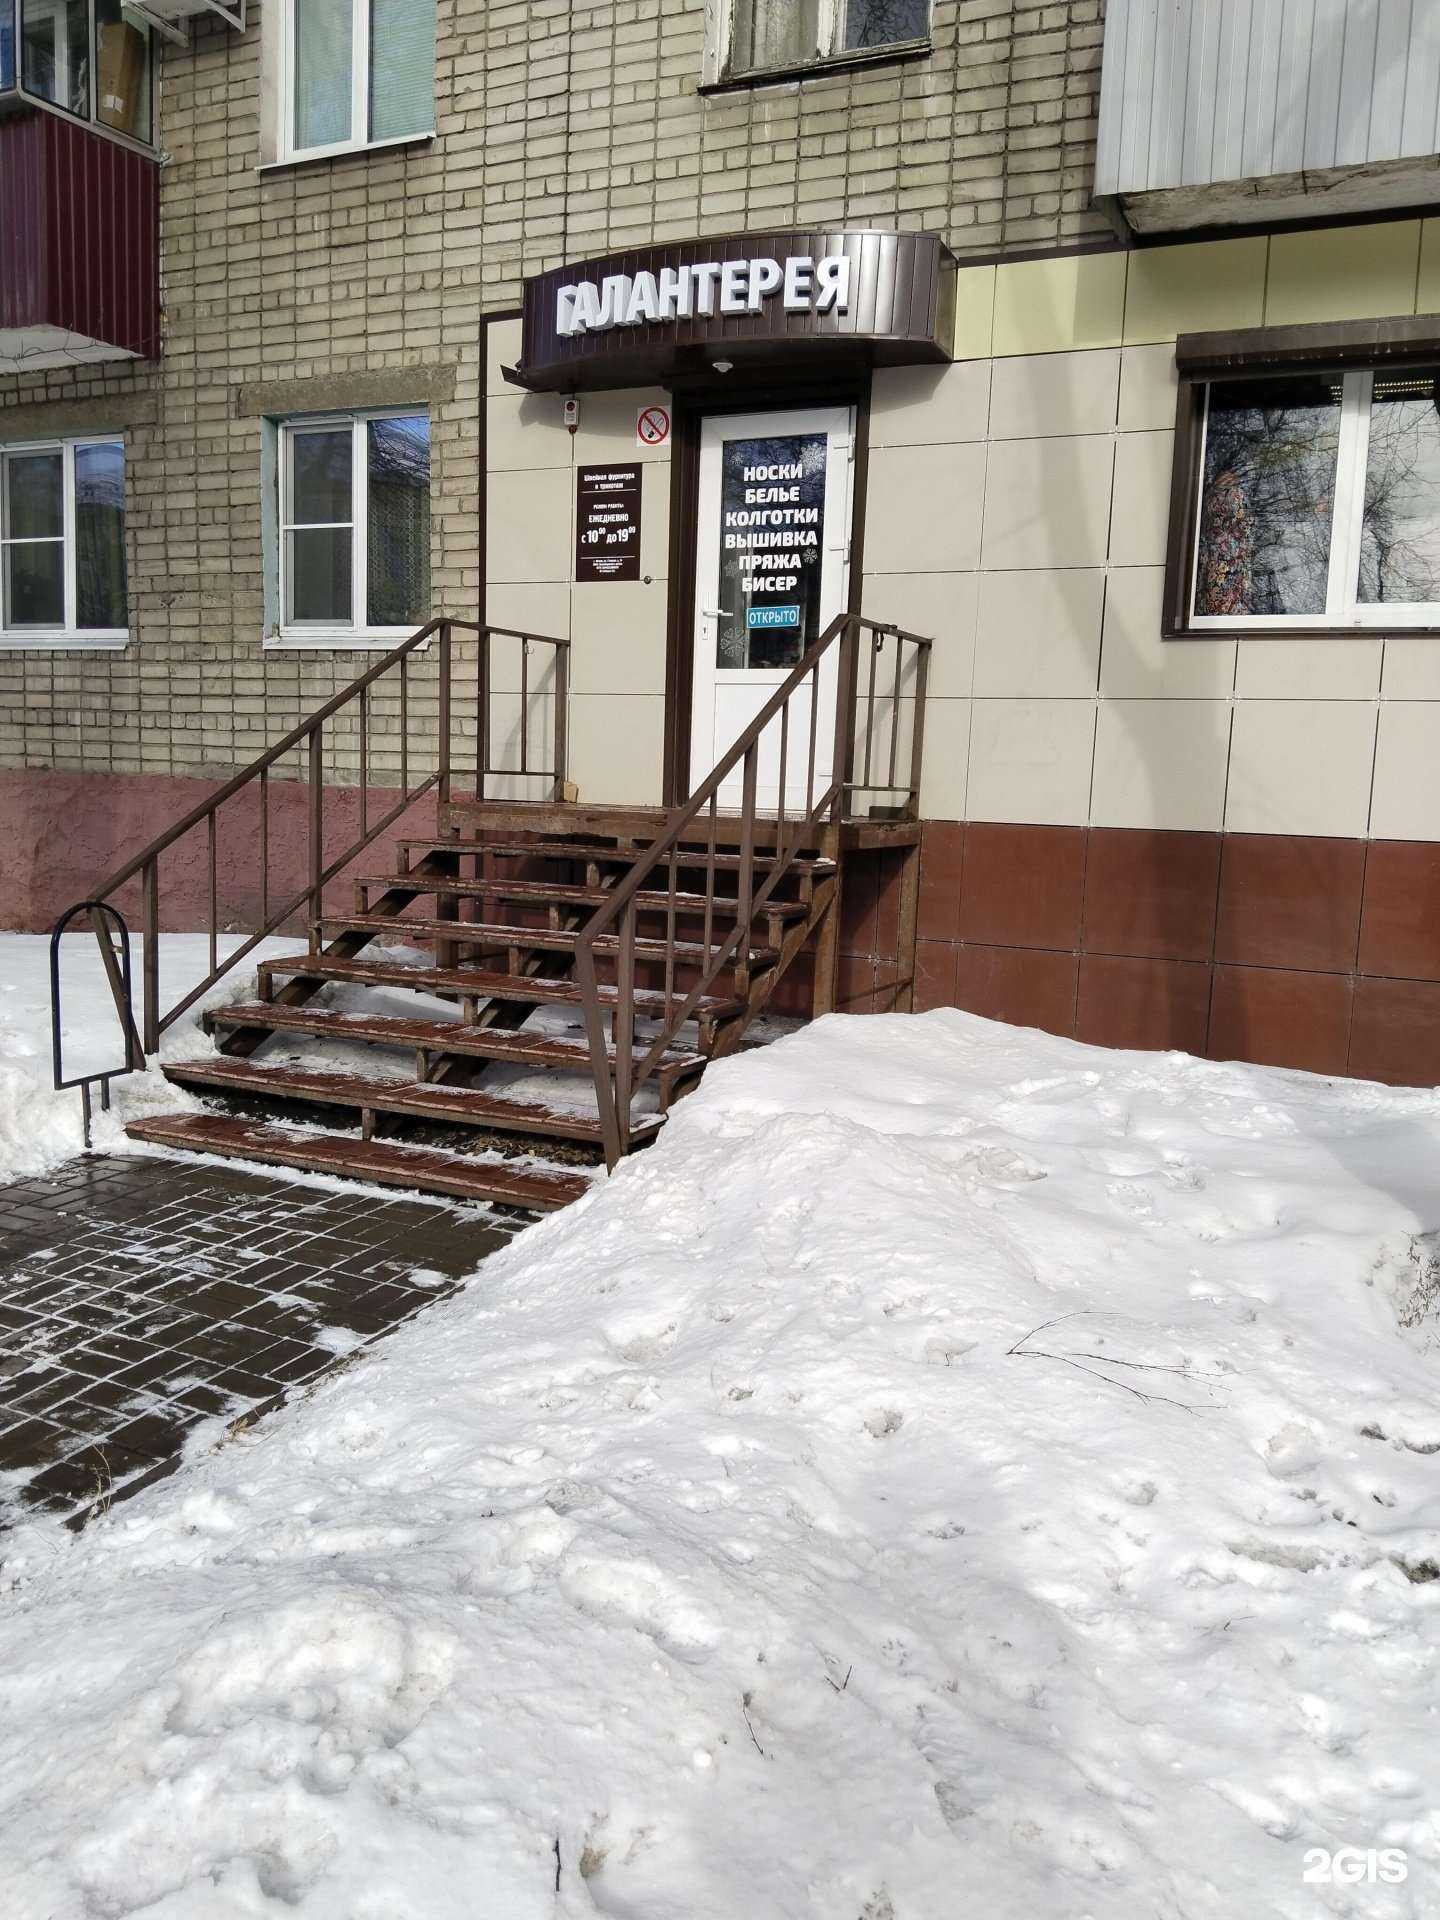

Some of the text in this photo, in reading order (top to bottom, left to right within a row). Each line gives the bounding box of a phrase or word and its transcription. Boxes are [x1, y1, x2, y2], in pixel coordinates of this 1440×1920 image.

[556, 255, 851, 337] ГАЛАНТЕРЕЯ
[743, 464, 803, 482] НОСКИ
[745, 487, 800, 504] БЕЛЬЕ
[588, 513, 629, 524] ЕЖЕДНЕВНО
[725, 508, 819, 527] КОЛГОТКИ
[606, 533, 618, 544] до
[725, 531, 818, 549] ВЫШИВКА
[739, 553, 802, 570] ПРЯЖА
[742, 576, 798, 592] БИСЕР
[749, 609, 797, 625] ОТКРЫТО
